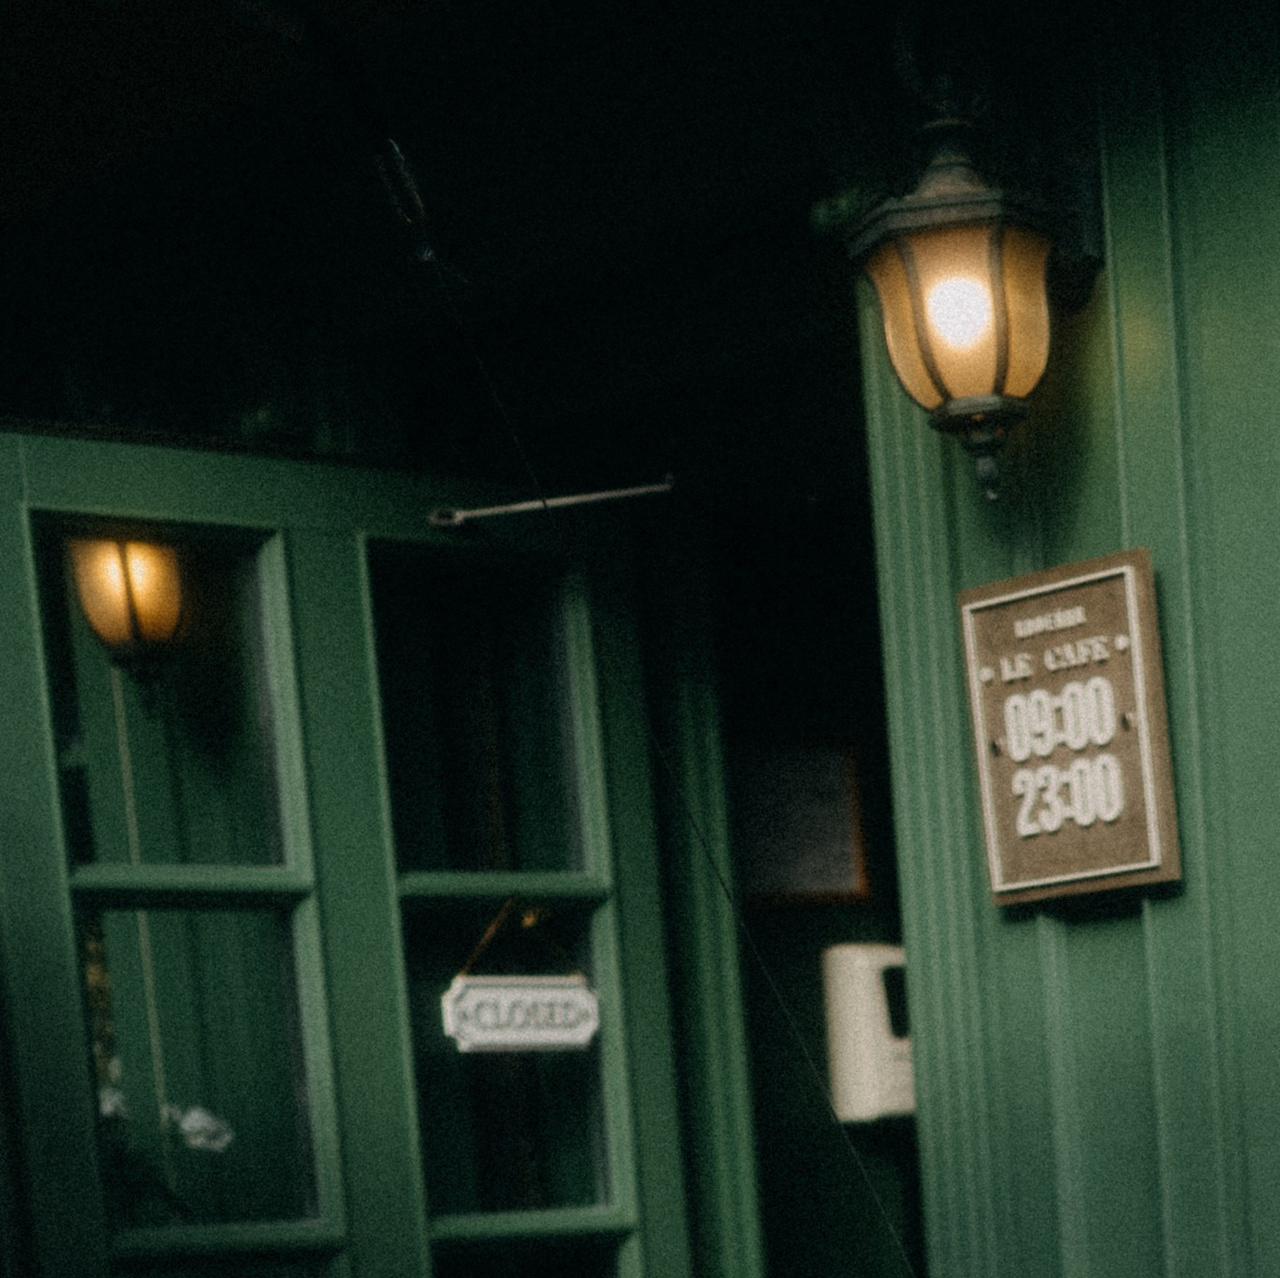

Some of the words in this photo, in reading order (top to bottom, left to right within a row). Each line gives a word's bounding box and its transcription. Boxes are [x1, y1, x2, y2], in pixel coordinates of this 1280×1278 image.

[1004, 675, 1116, 762] 09:00
[1011, 752, 1124, 837] 23:00
[474, 1000, 582, 1031] CLOSED
